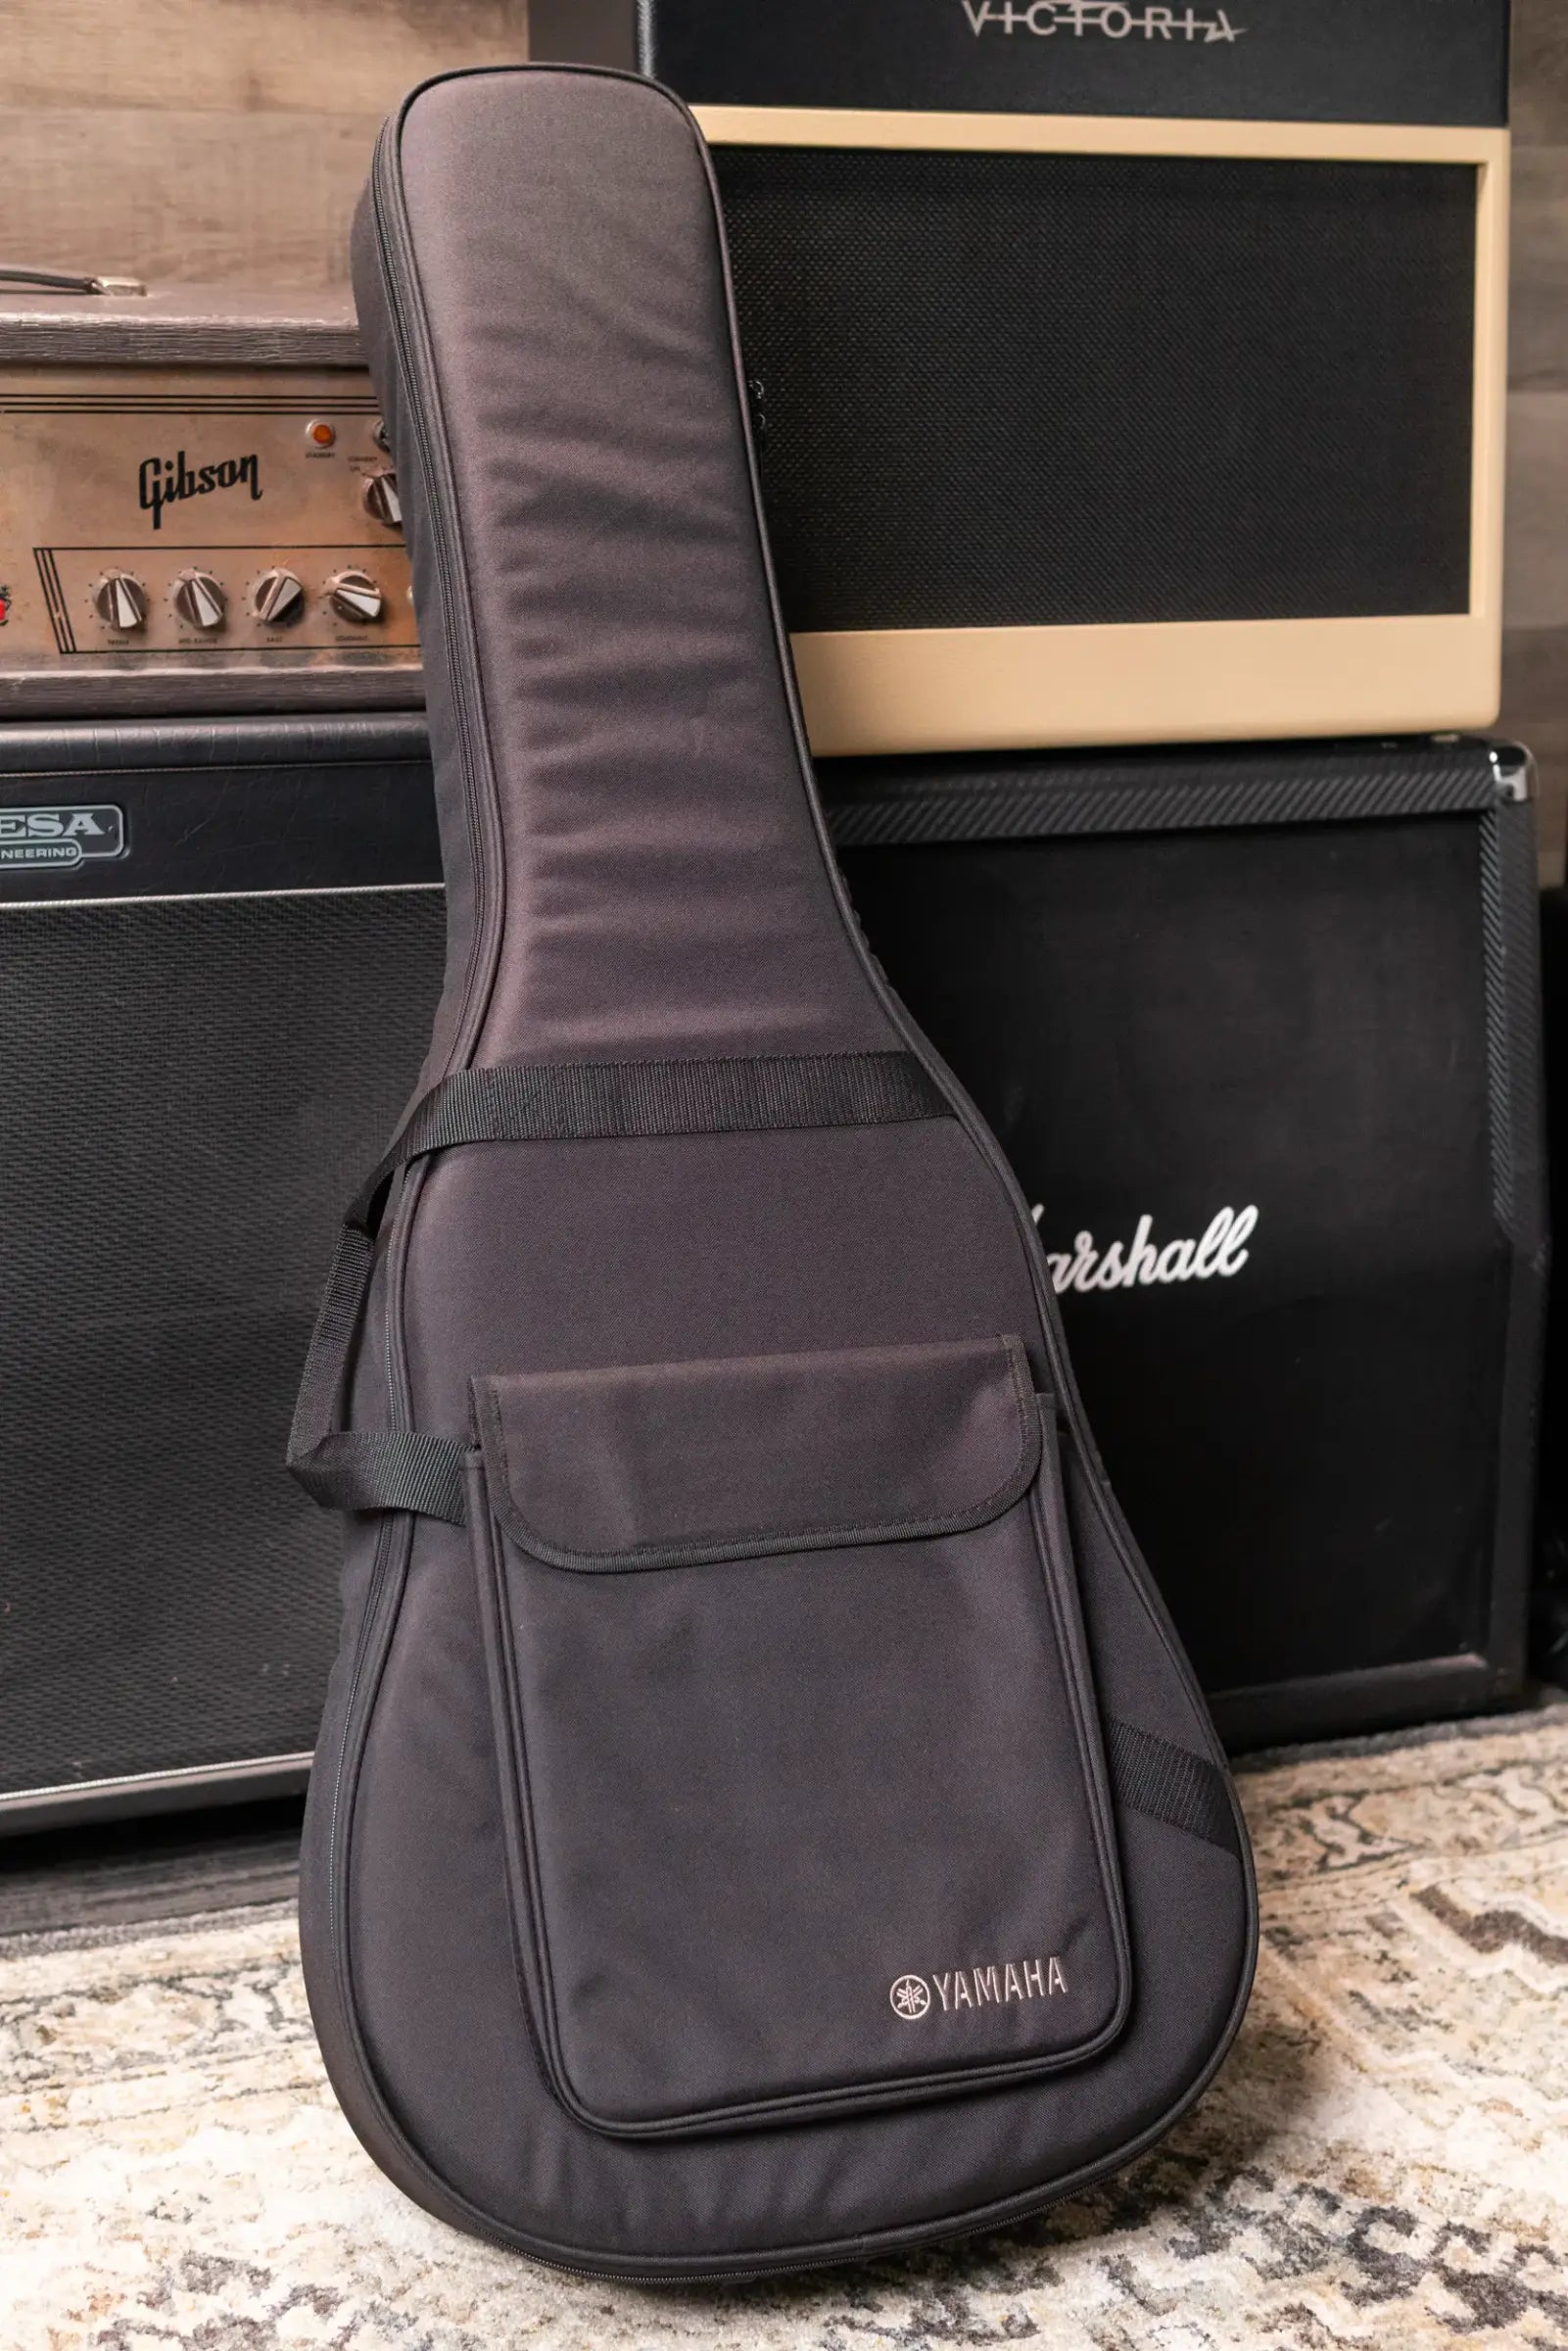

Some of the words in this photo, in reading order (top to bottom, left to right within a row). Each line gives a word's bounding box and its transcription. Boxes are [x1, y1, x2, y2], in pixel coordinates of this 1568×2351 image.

[962, 0, 1248, 43] VICTORIA
[138, 451, 263, 530] Gibson
[1031, 1204, 1259, 1294] arshall
[932, 1956, 1069, 2011] YAMAHA
